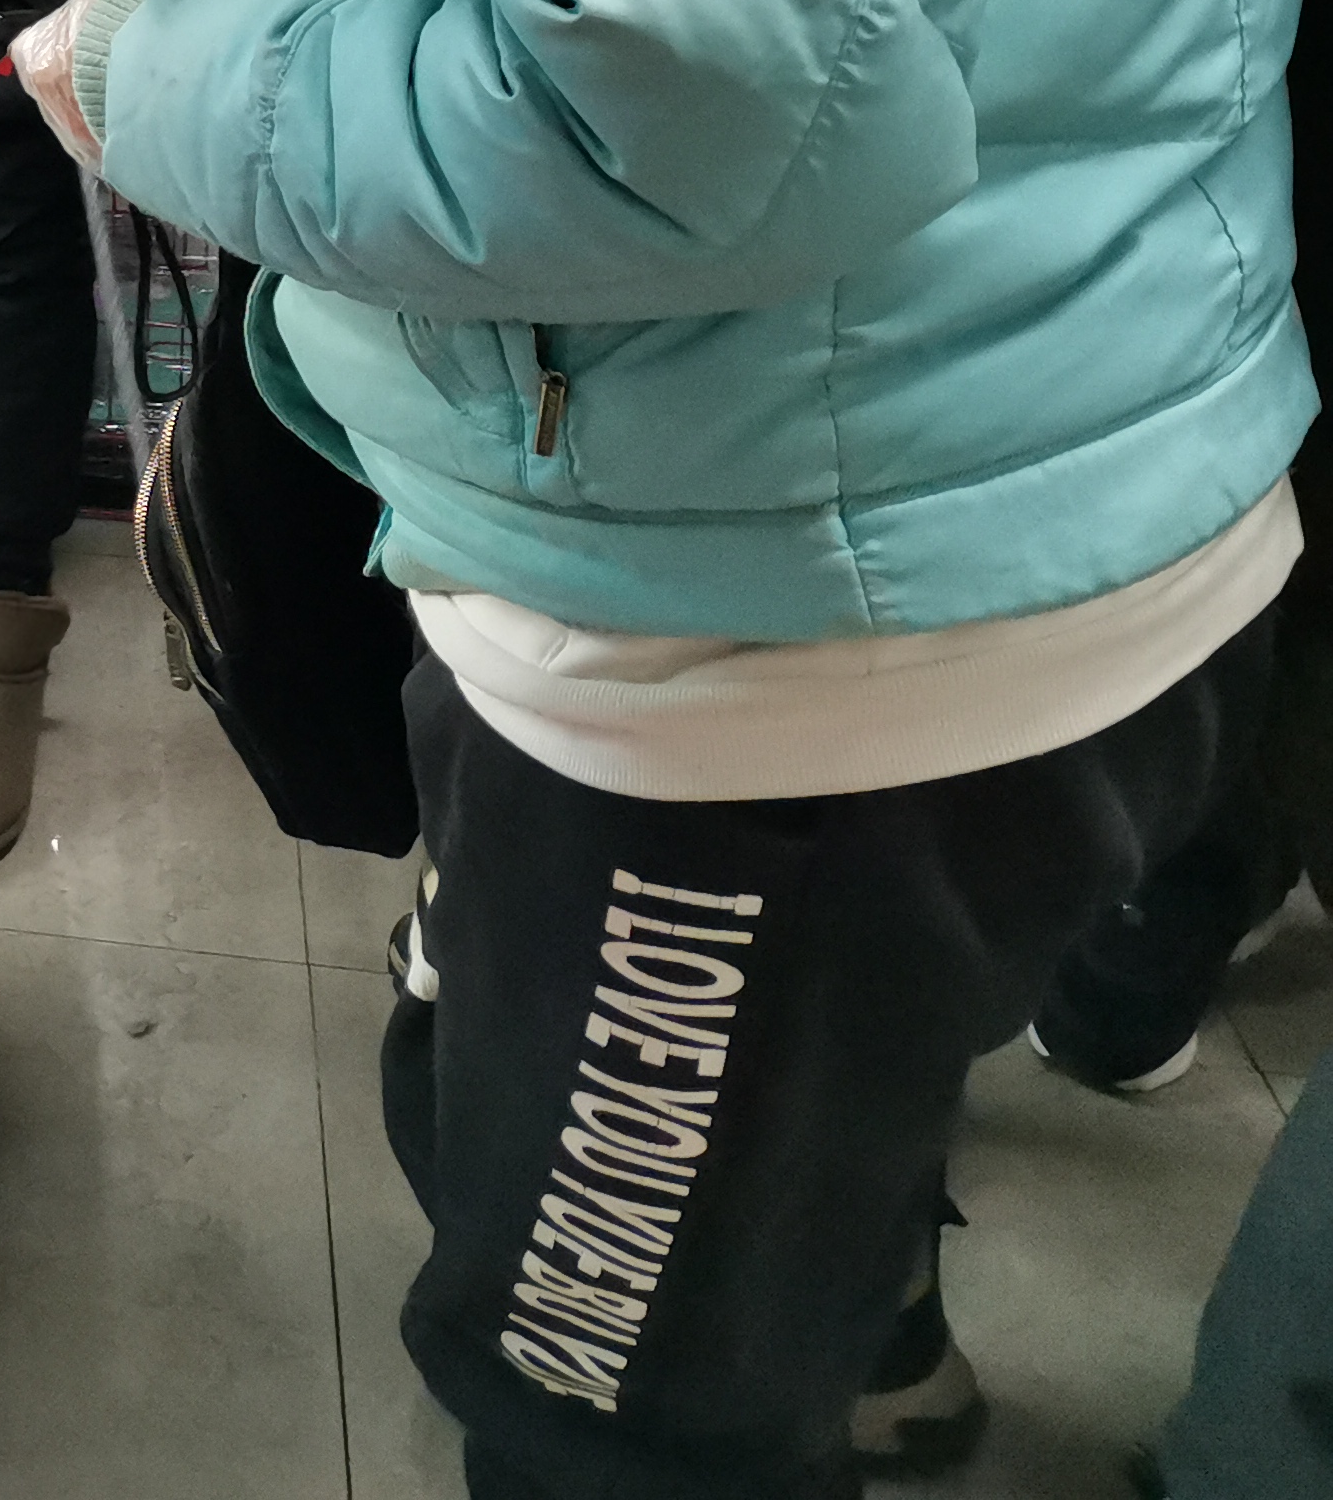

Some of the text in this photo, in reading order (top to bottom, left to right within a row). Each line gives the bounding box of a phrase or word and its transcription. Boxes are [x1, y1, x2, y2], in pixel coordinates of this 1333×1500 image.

[611, 868, 763, 917] I
[585, 905, 754, 1079] LOVE
[559, 1060, 719, 1197] YOU
